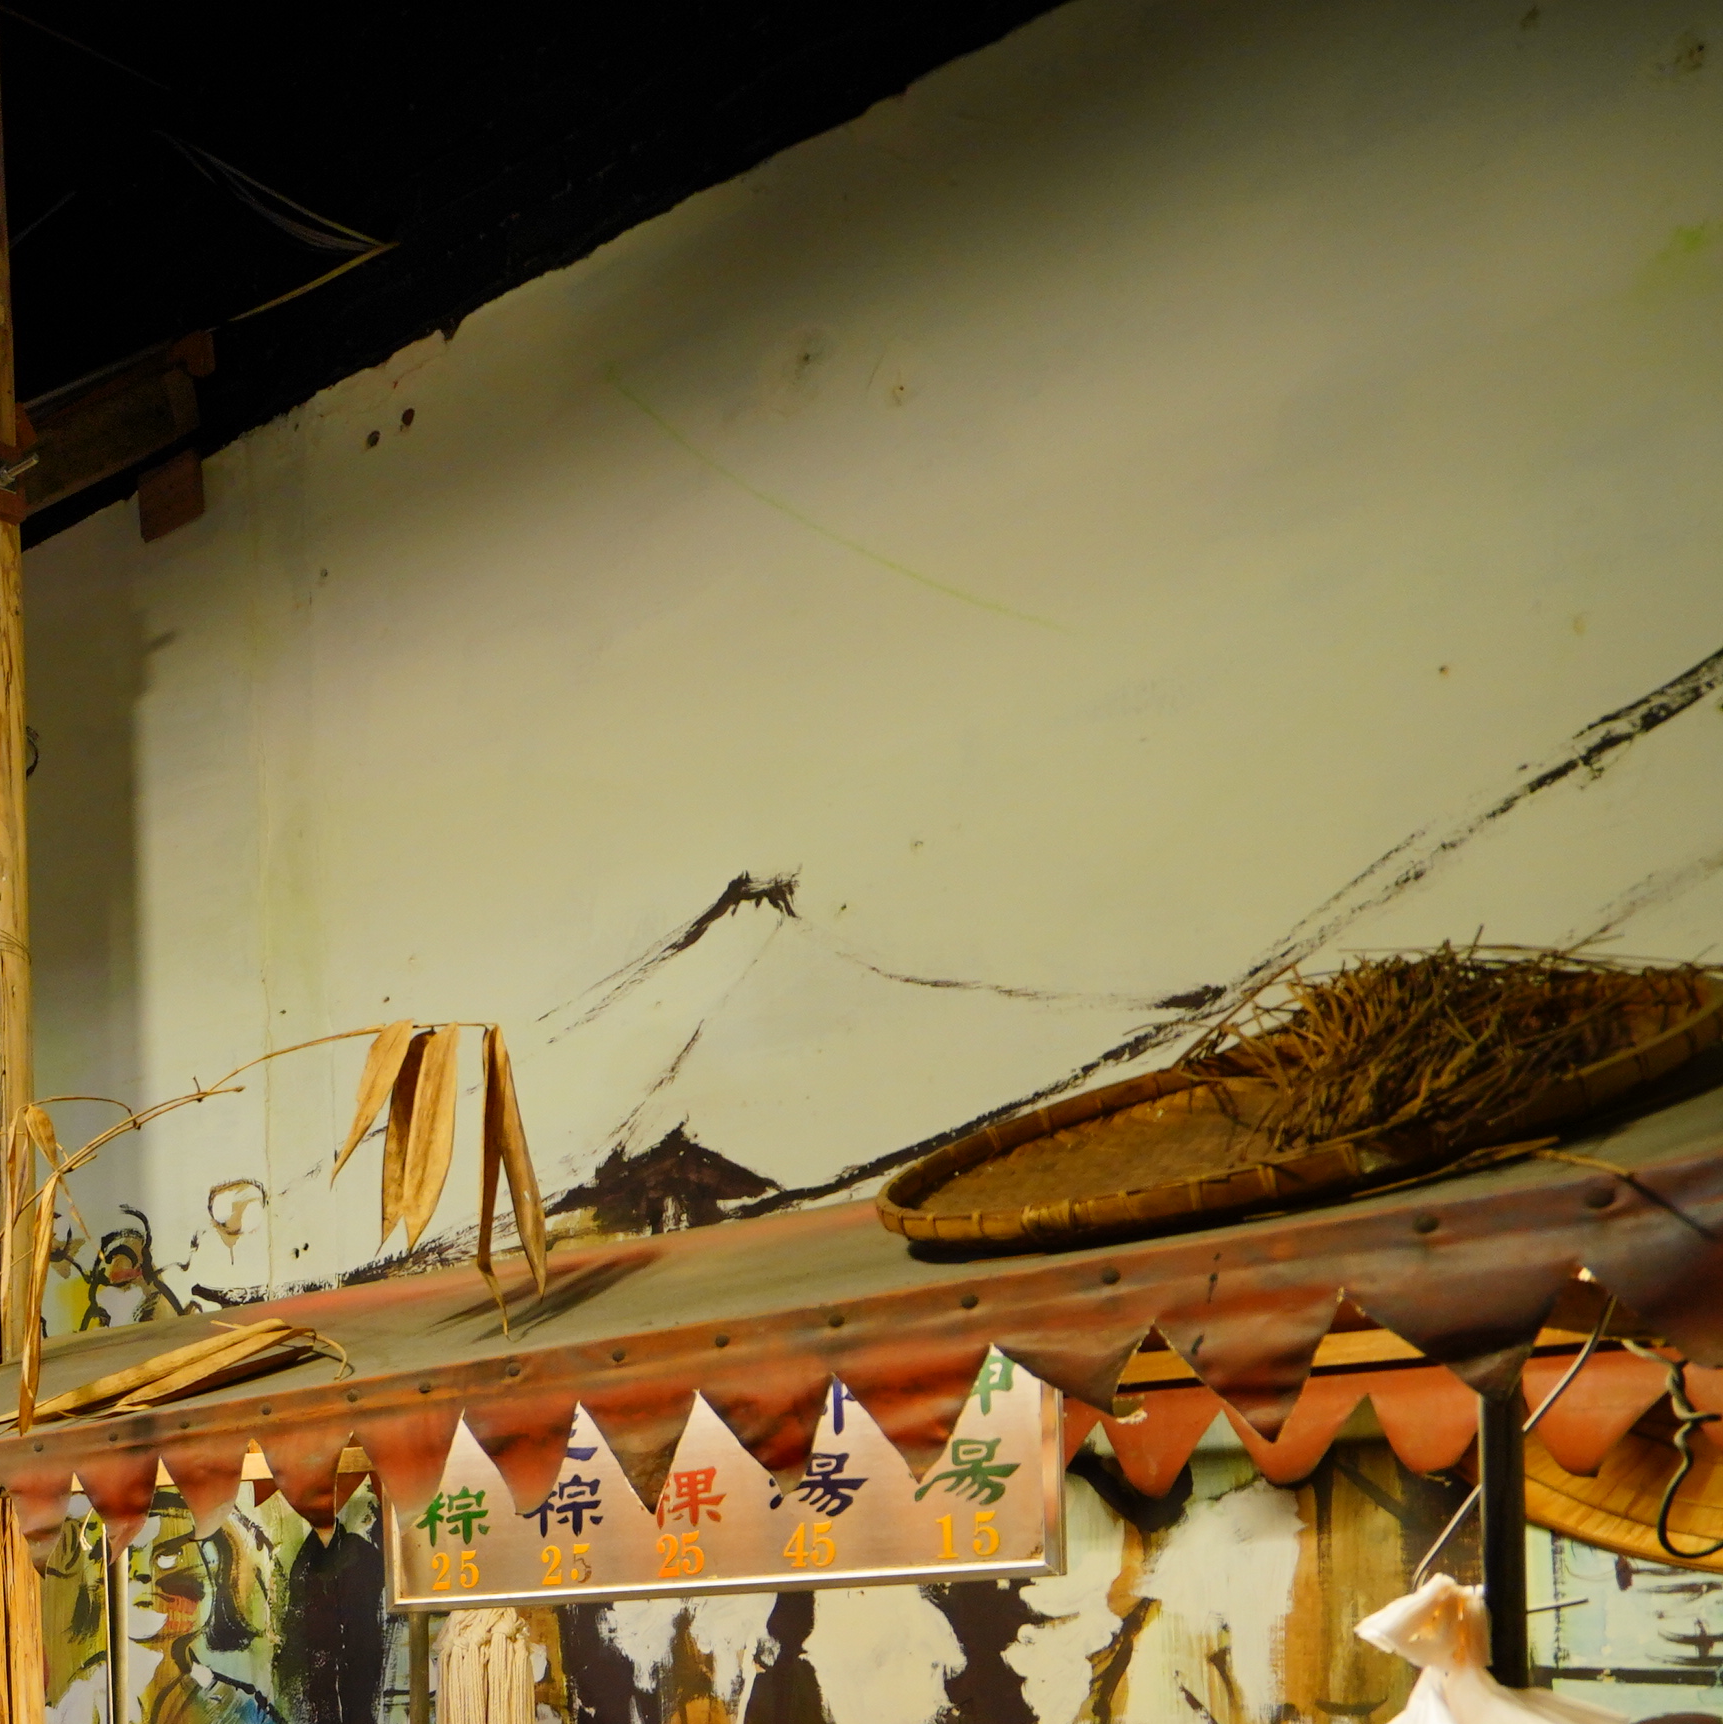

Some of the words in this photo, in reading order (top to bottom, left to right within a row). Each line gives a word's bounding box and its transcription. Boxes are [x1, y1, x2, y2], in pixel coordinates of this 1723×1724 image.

[656, 1530, 706, 1578] 25
[782, 1520, 837, 1568] 45
[935, 1510, 1001, 1560] 15
[431, 1549, 481, 1592] 25
[540, 1542, 592, 1586] 25
